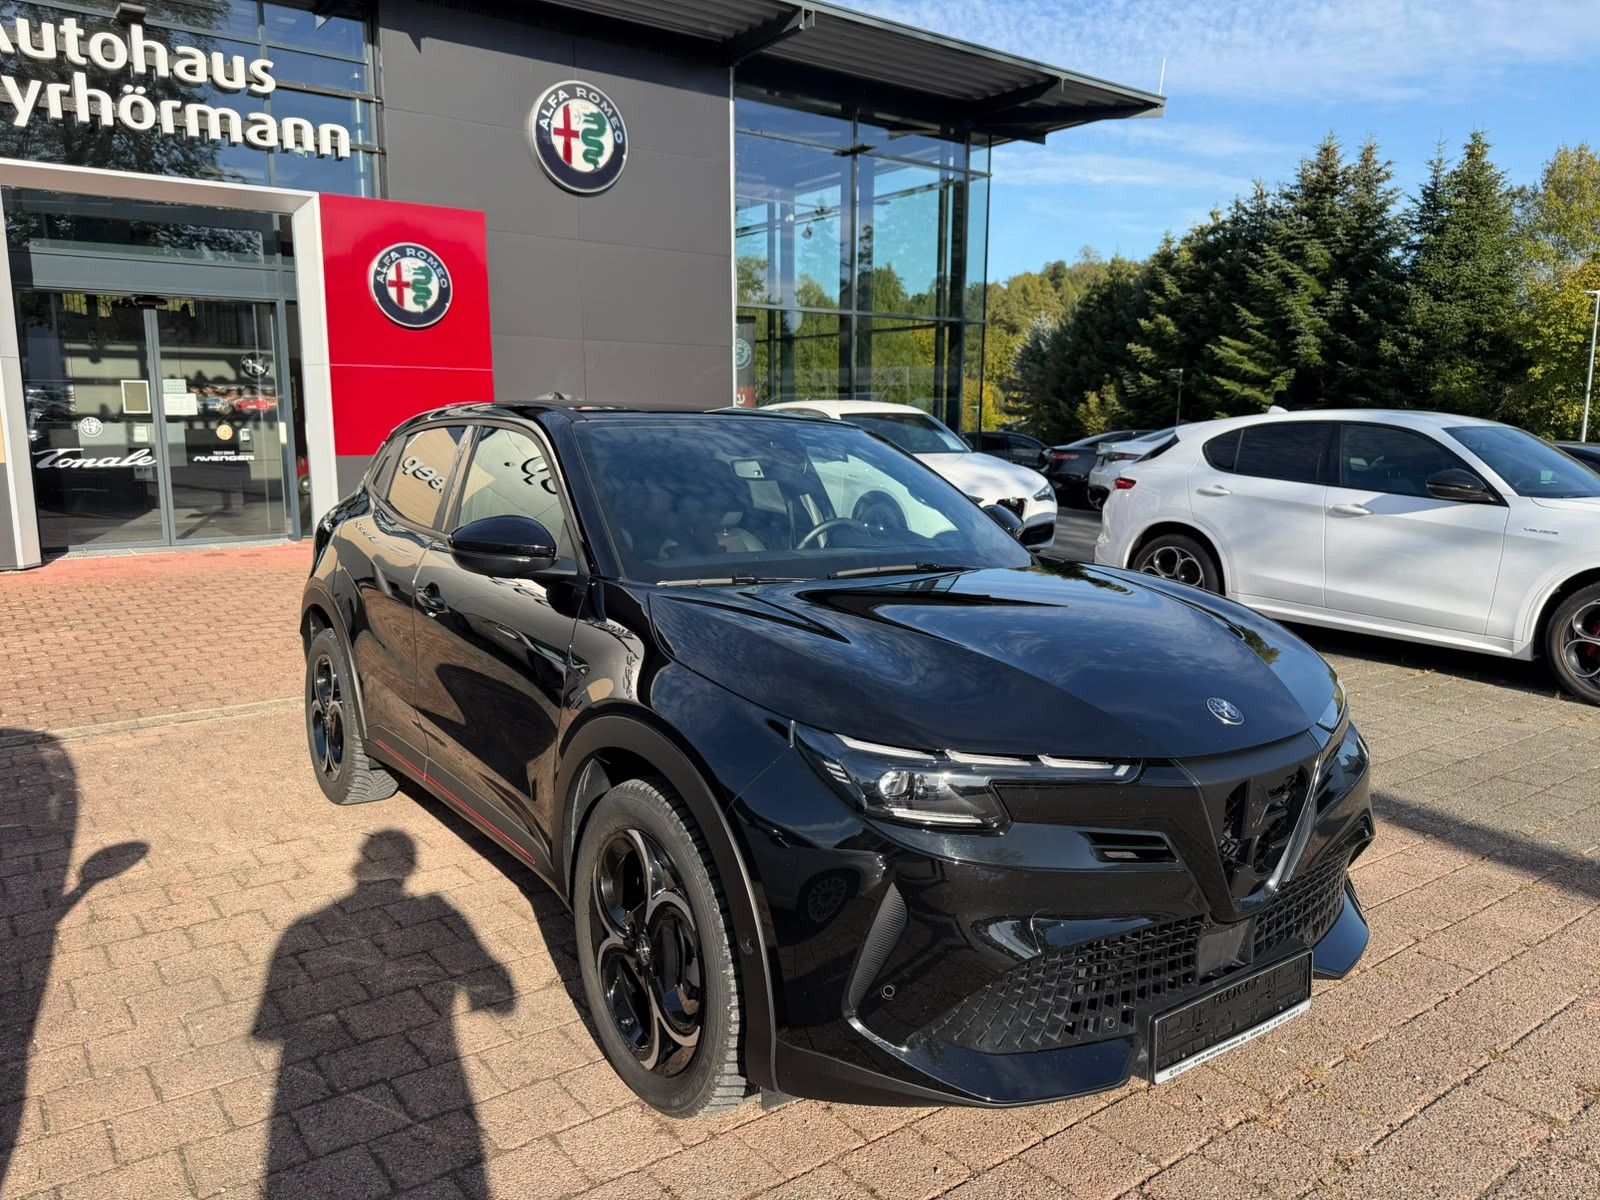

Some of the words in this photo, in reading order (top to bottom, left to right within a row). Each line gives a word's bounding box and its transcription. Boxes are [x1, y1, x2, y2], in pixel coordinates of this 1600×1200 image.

[539, 90, 570, 131] ALFA
[576, 87, 624, 144] ROMEO
[376, 251, 401, 284] ALFA
[405, 247, 448, 289] ROMEO
[32, 448, 157, 469] Tonale
